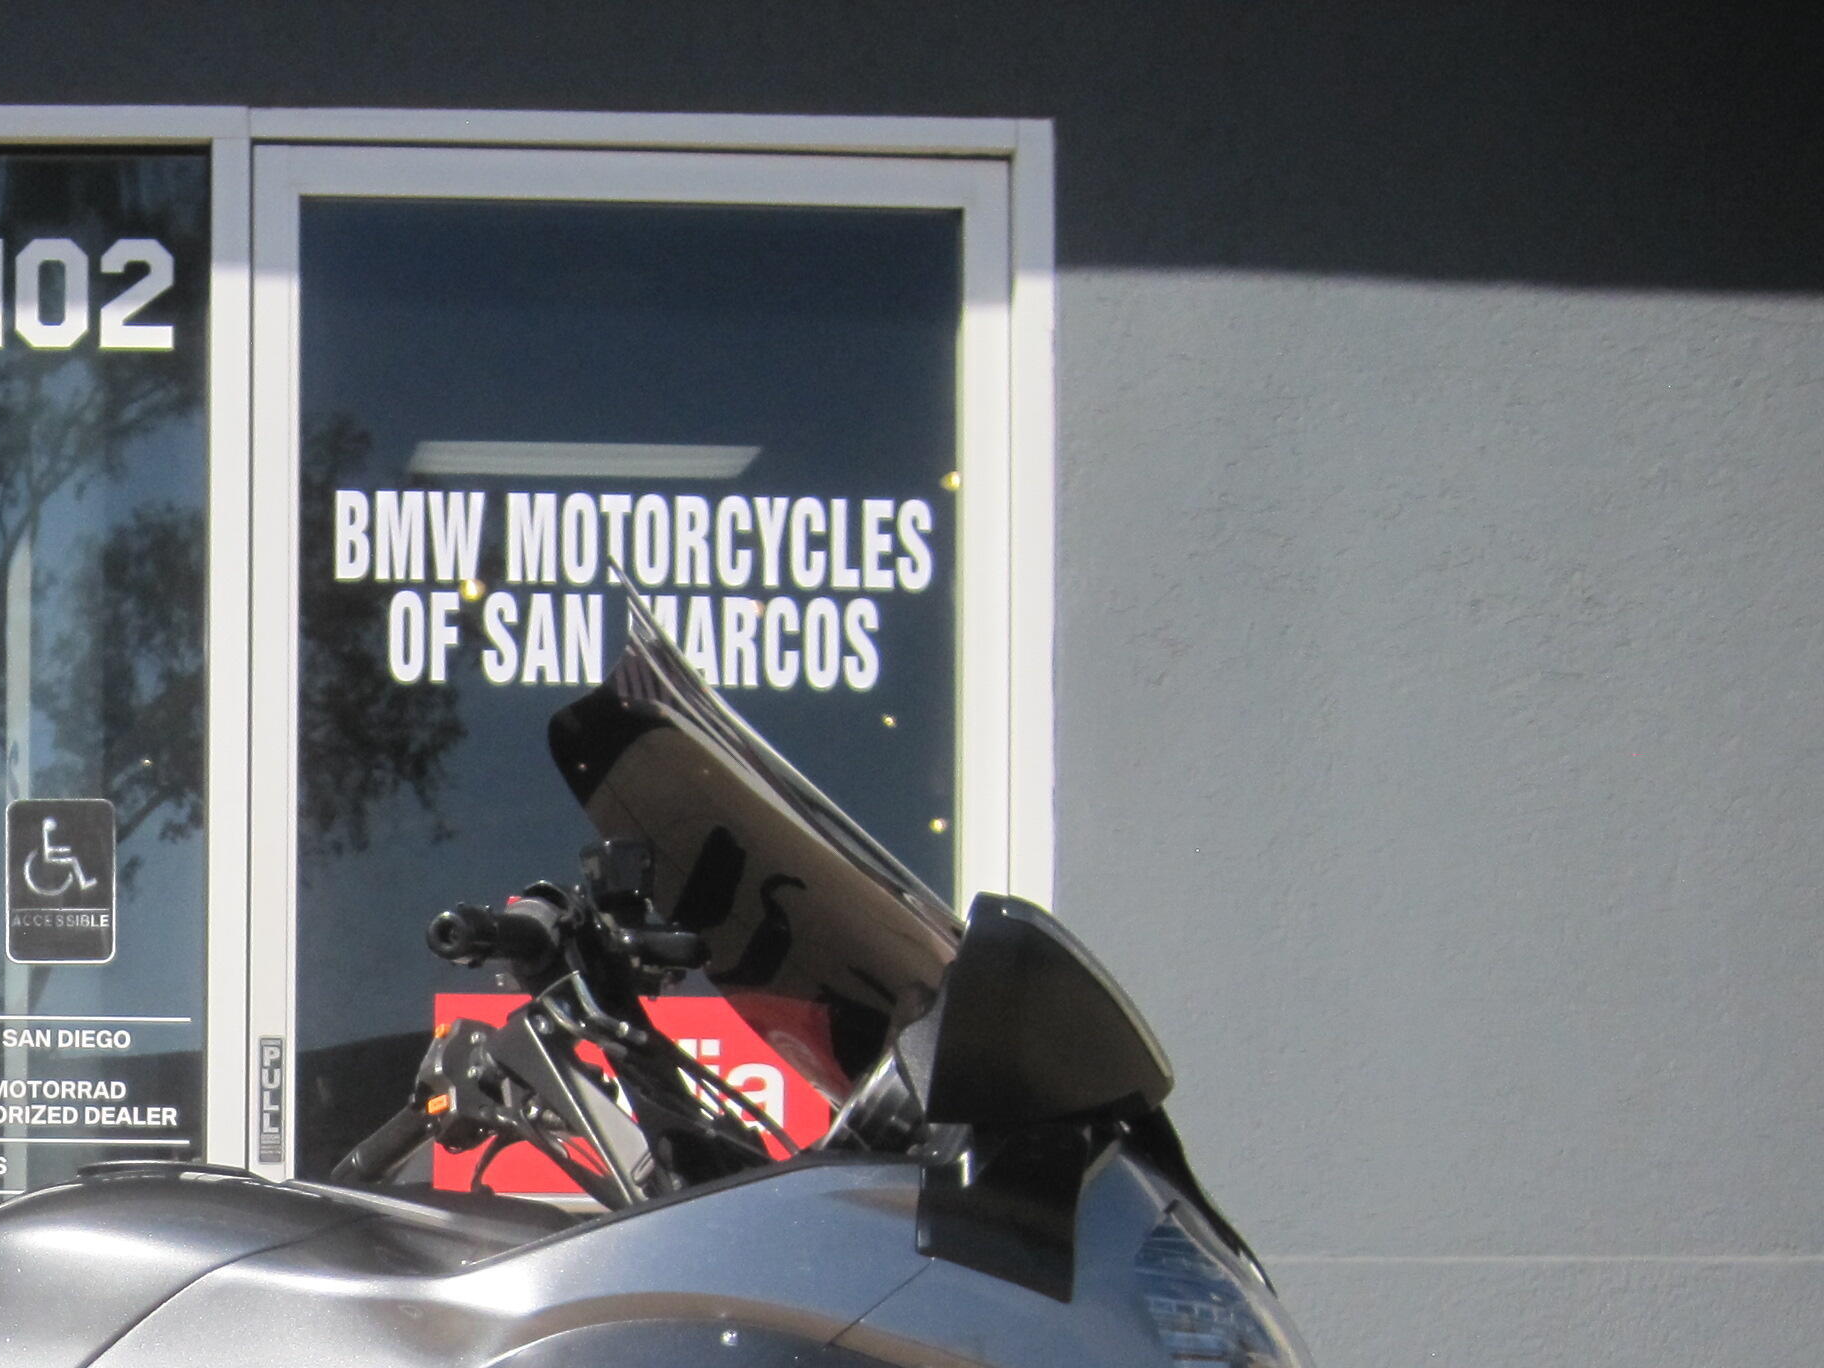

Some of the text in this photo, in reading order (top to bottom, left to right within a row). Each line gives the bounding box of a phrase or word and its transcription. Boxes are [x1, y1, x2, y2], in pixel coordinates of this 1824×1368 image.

[334, 489, 933, 592] BMW MOTORCYCLES
[387, 590, 460, 684] OF
[482, 590, 604, 685] SAN
[11, 914, 110, 928] ACCESSIBLE
[3, 1028, 51, 1049] SAN
[57, 1029, 132, 1049] DIEGO
[261, 1045, 281, 1133] PULL
[84, 1106, 177, 1127] DEALER
